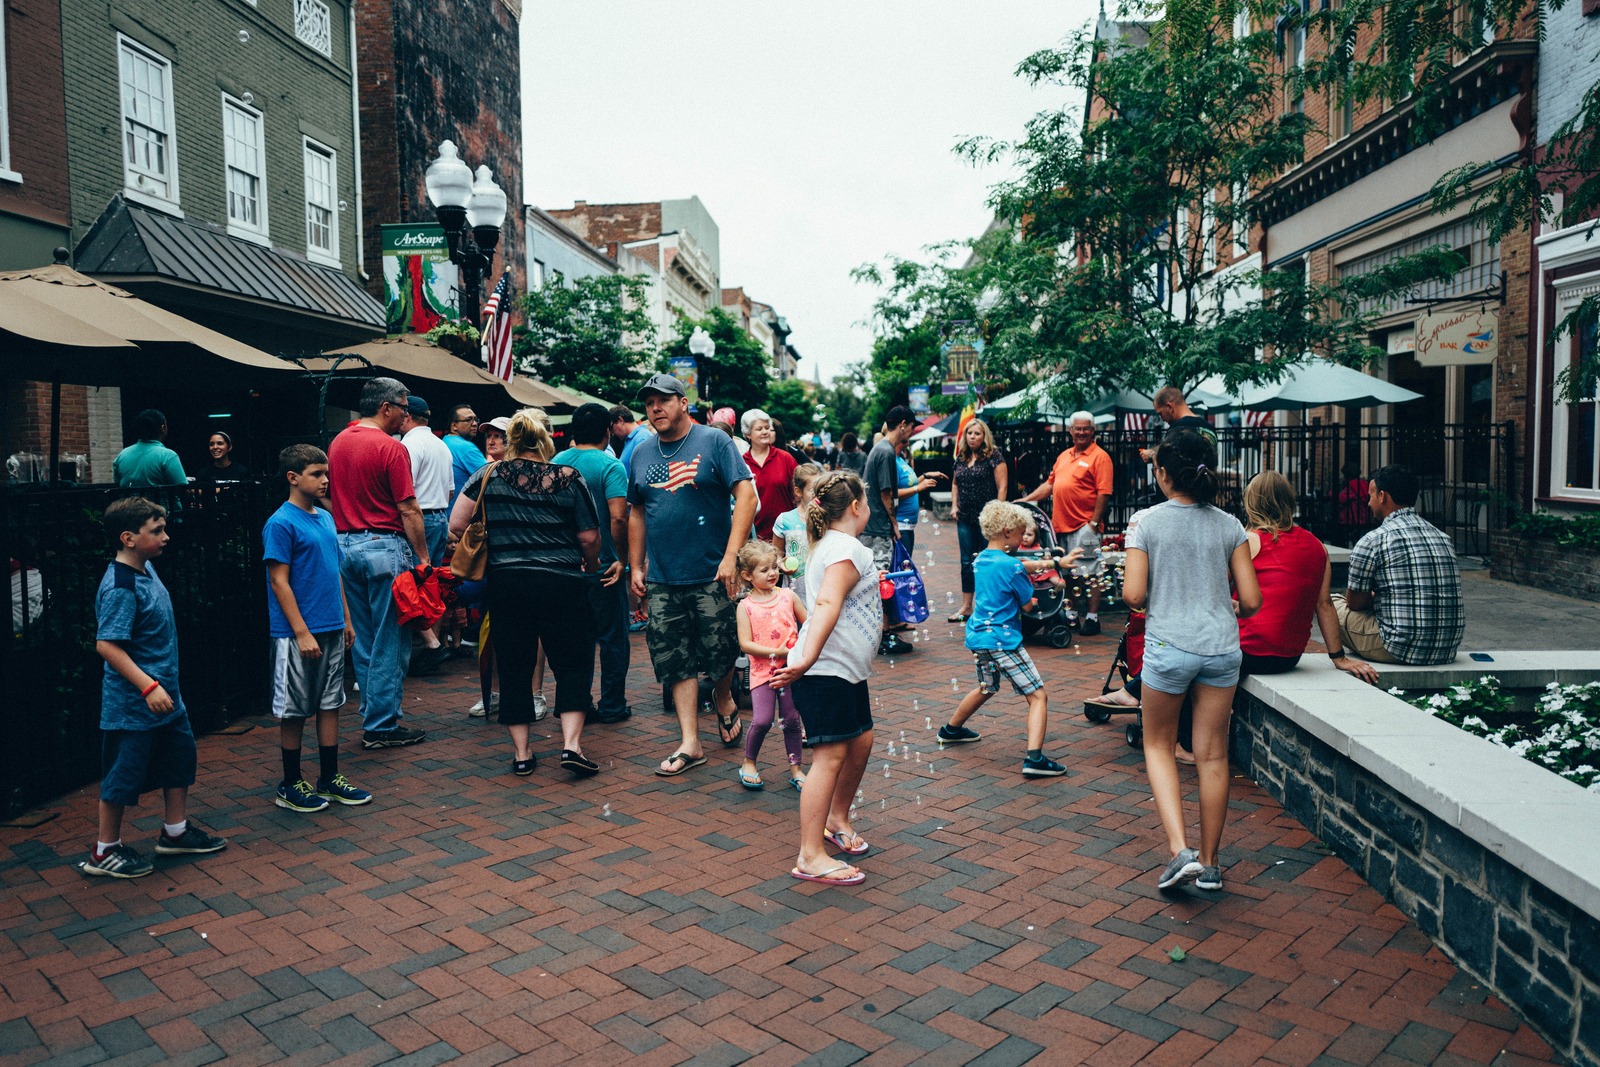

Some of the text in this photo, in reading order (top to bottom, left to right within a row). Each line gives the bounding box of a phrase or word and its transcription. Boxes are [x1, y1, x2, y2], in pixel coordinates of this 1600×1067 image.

[394, 233, 444, 247] ArtScape
[1417, 313, 1469, 355] Espresso
[1440, 342, 1458, 350] BAR
